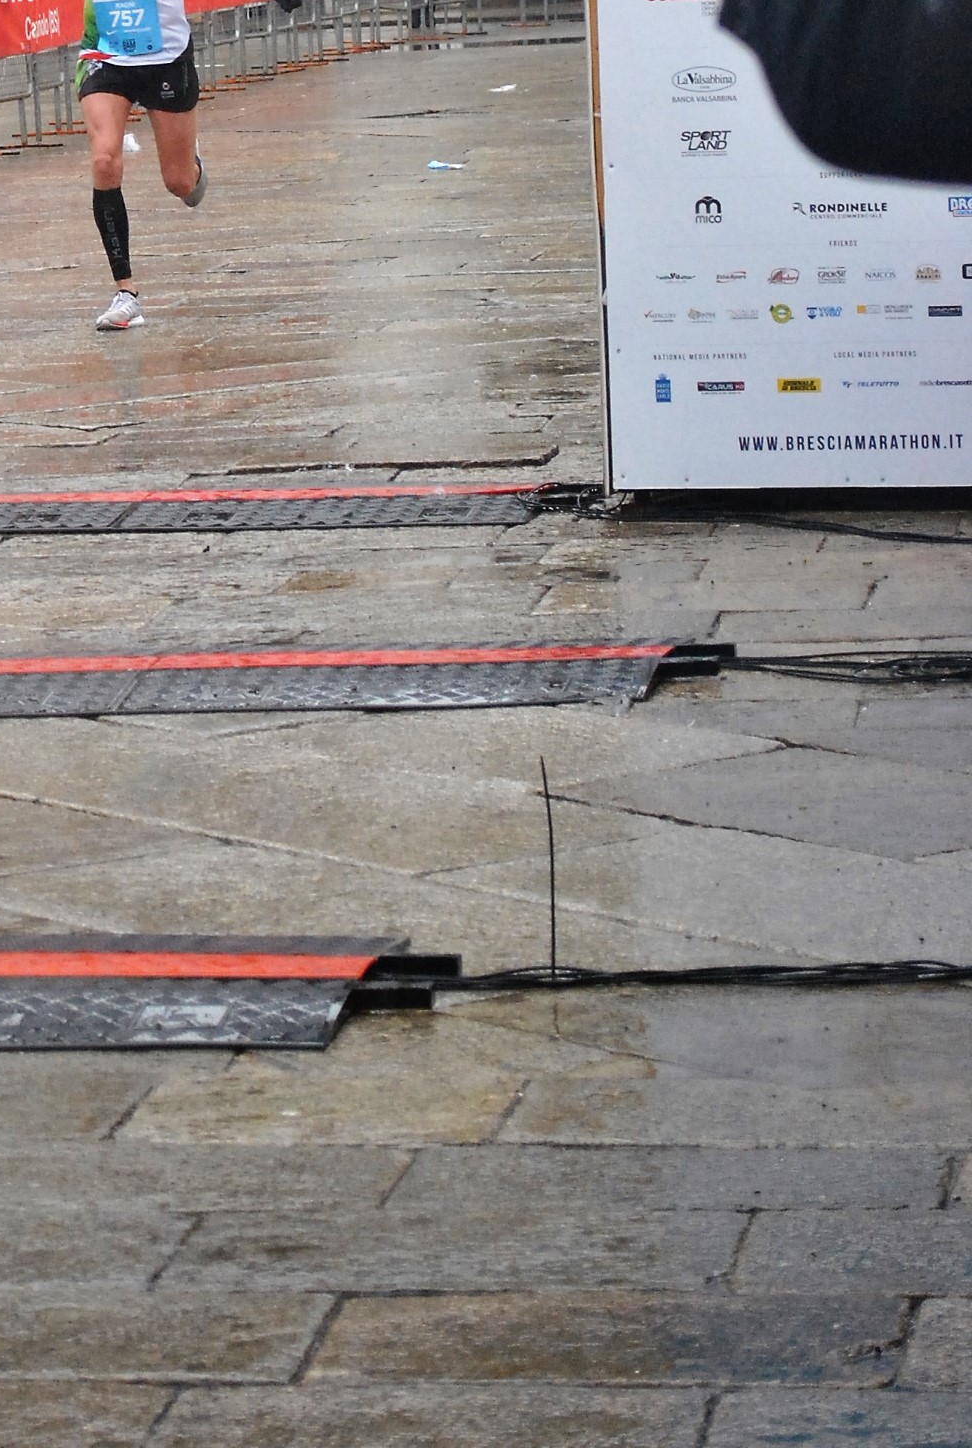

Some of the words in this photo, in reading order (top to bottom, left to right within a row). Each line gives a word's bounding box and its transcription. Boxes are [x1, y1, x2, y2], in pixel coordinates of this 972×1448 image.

[109, 8, 145, 28] 757
[681, 130, 732, 142] SPORT
[688, 140, 728, 151] LAND
[809, 202, 888, 213] RONDINELLE
[695, 215, 722, 224] mico
[739, 434, 963, 451] WWW.BRESCIAMARATHON.IT
